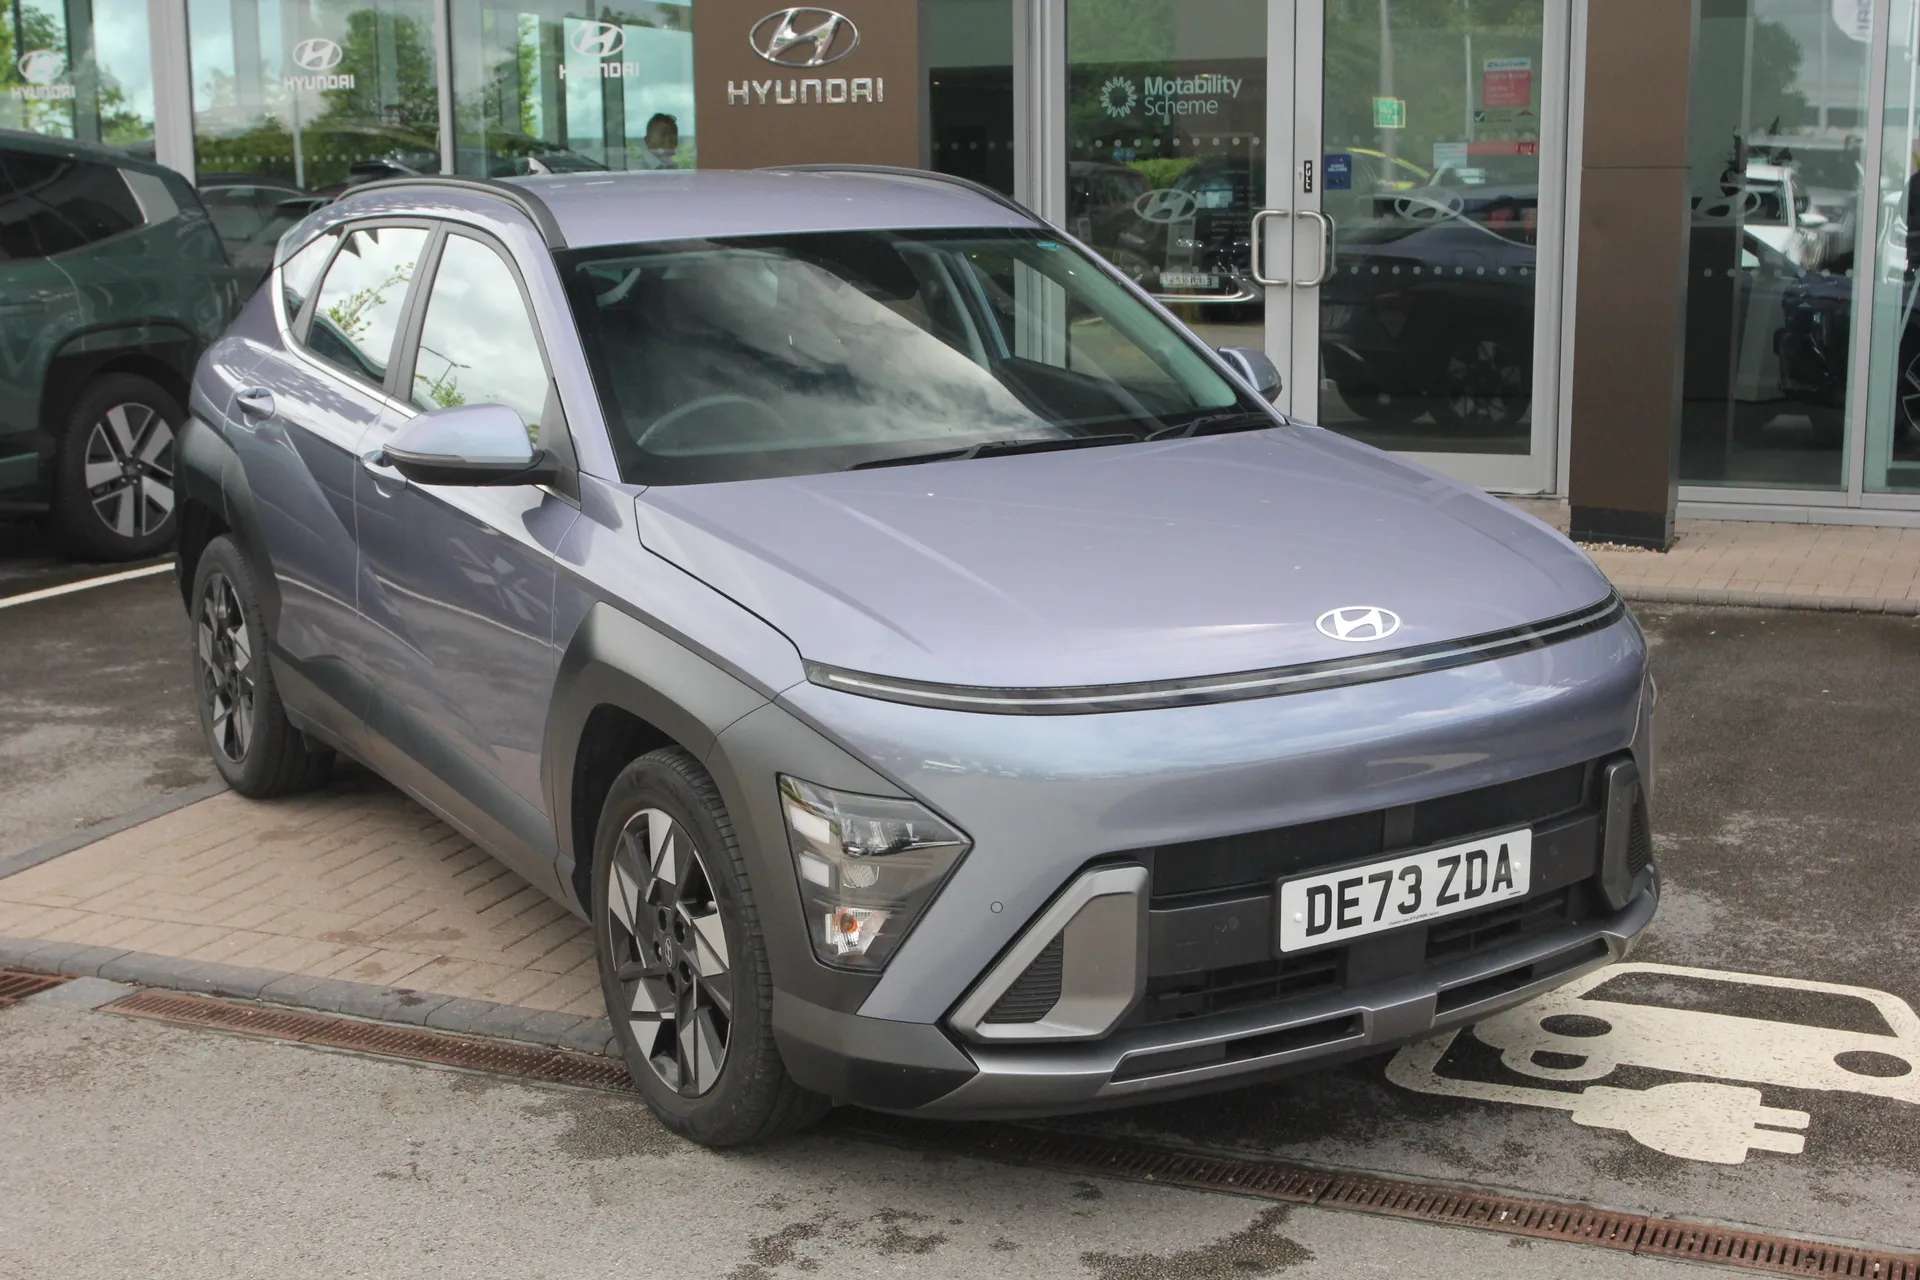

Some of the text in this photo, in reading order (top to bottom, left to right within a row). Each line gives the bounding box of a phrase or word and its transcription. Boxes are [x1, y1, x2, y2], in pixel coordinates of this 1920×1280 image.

[559, 62, 640, 80] HNDAI
[10, 85, 76, 100] HYUNDAI
[284, 74, 355, 91] HYUNDAI
[727, 77, 884, 105] HYUNDAI
[1144, 74, 1242, 99] Motability
[1144, 96, 1218, 116] Scheme
[1305, 843, 1514, 938] DE73 ZDA
